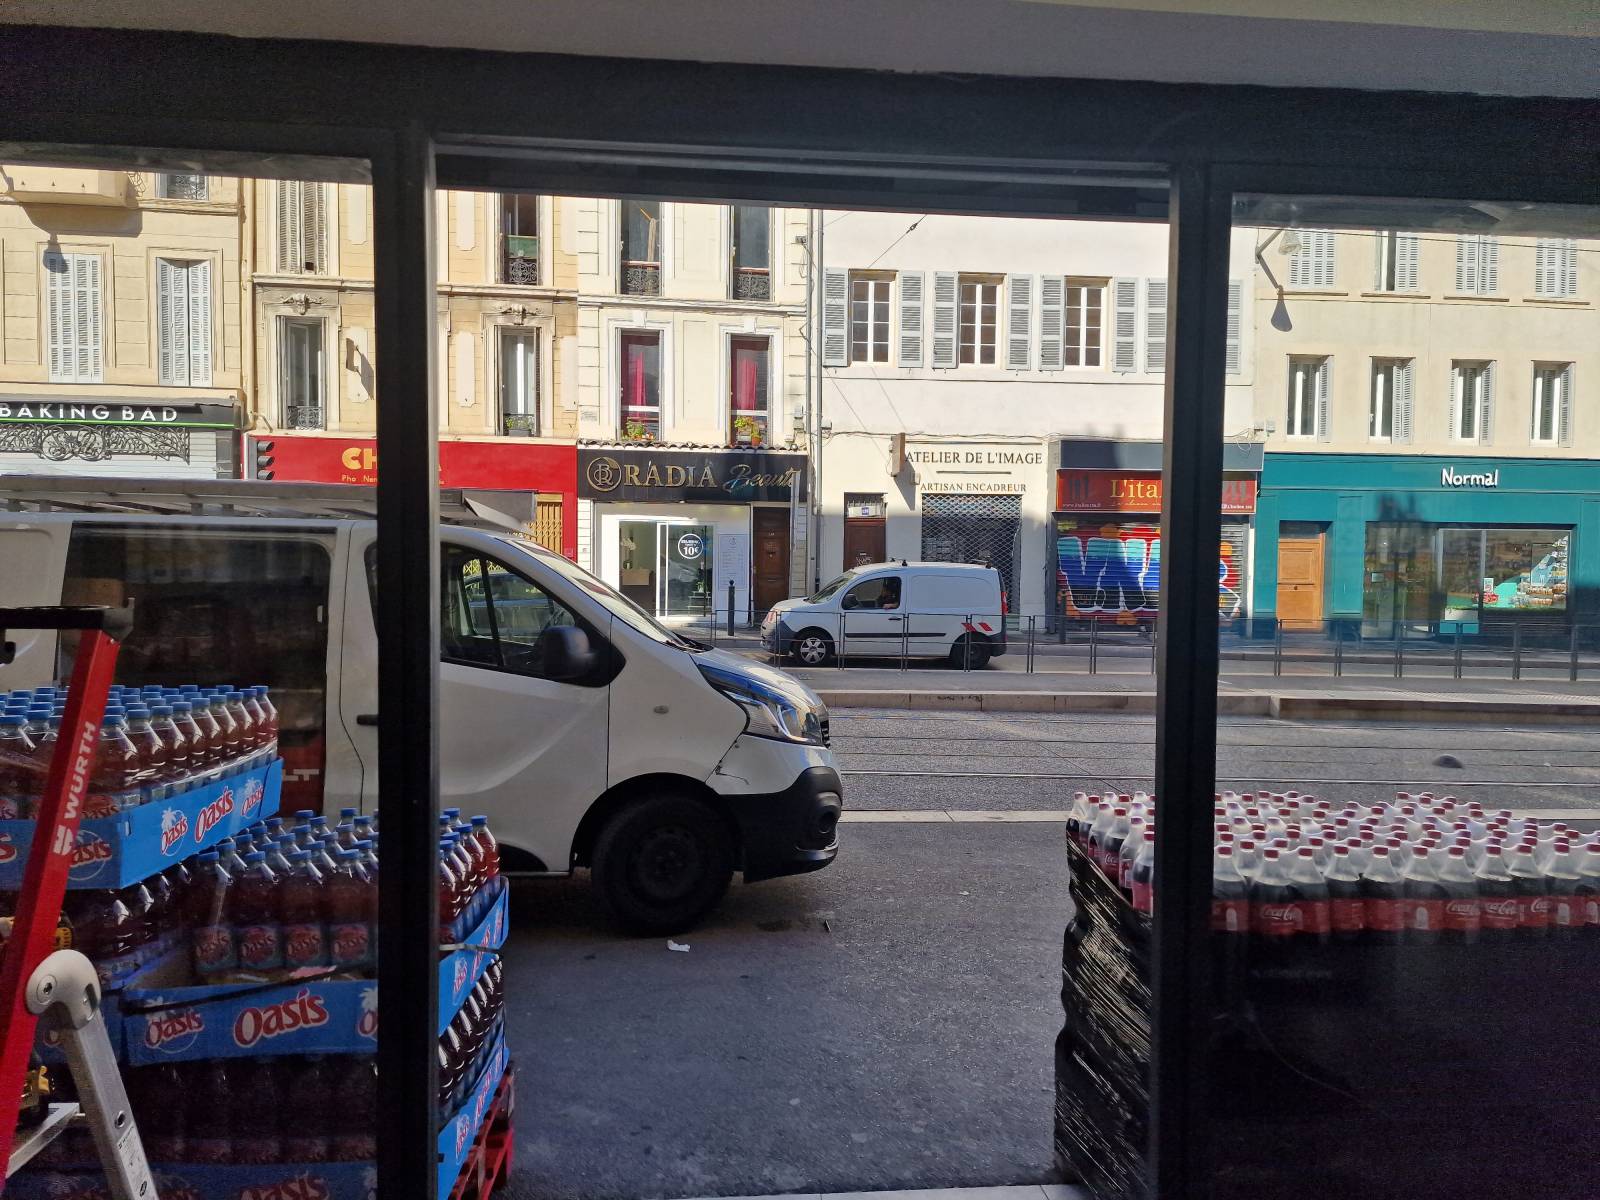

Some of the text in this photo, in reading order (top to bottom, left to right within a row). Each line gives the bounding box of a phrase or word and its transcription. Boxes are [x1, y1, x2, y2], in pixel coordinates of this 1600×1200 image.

[122, 406, 178, 422] BAD
[905, 451, 1042, 464] ATELIER DE L'IMAGE
[1442, 466, 1498, 487] Normal
[921, 483, 1026, 492] ARTISAN ENCADREUR
[1110, 478, 1162, 498] L'ita
[195, 785, 234, 843] Oasis
[145, 1007, 205, 1048] Oasis
[233, 988, 329, 1049] Oasis
